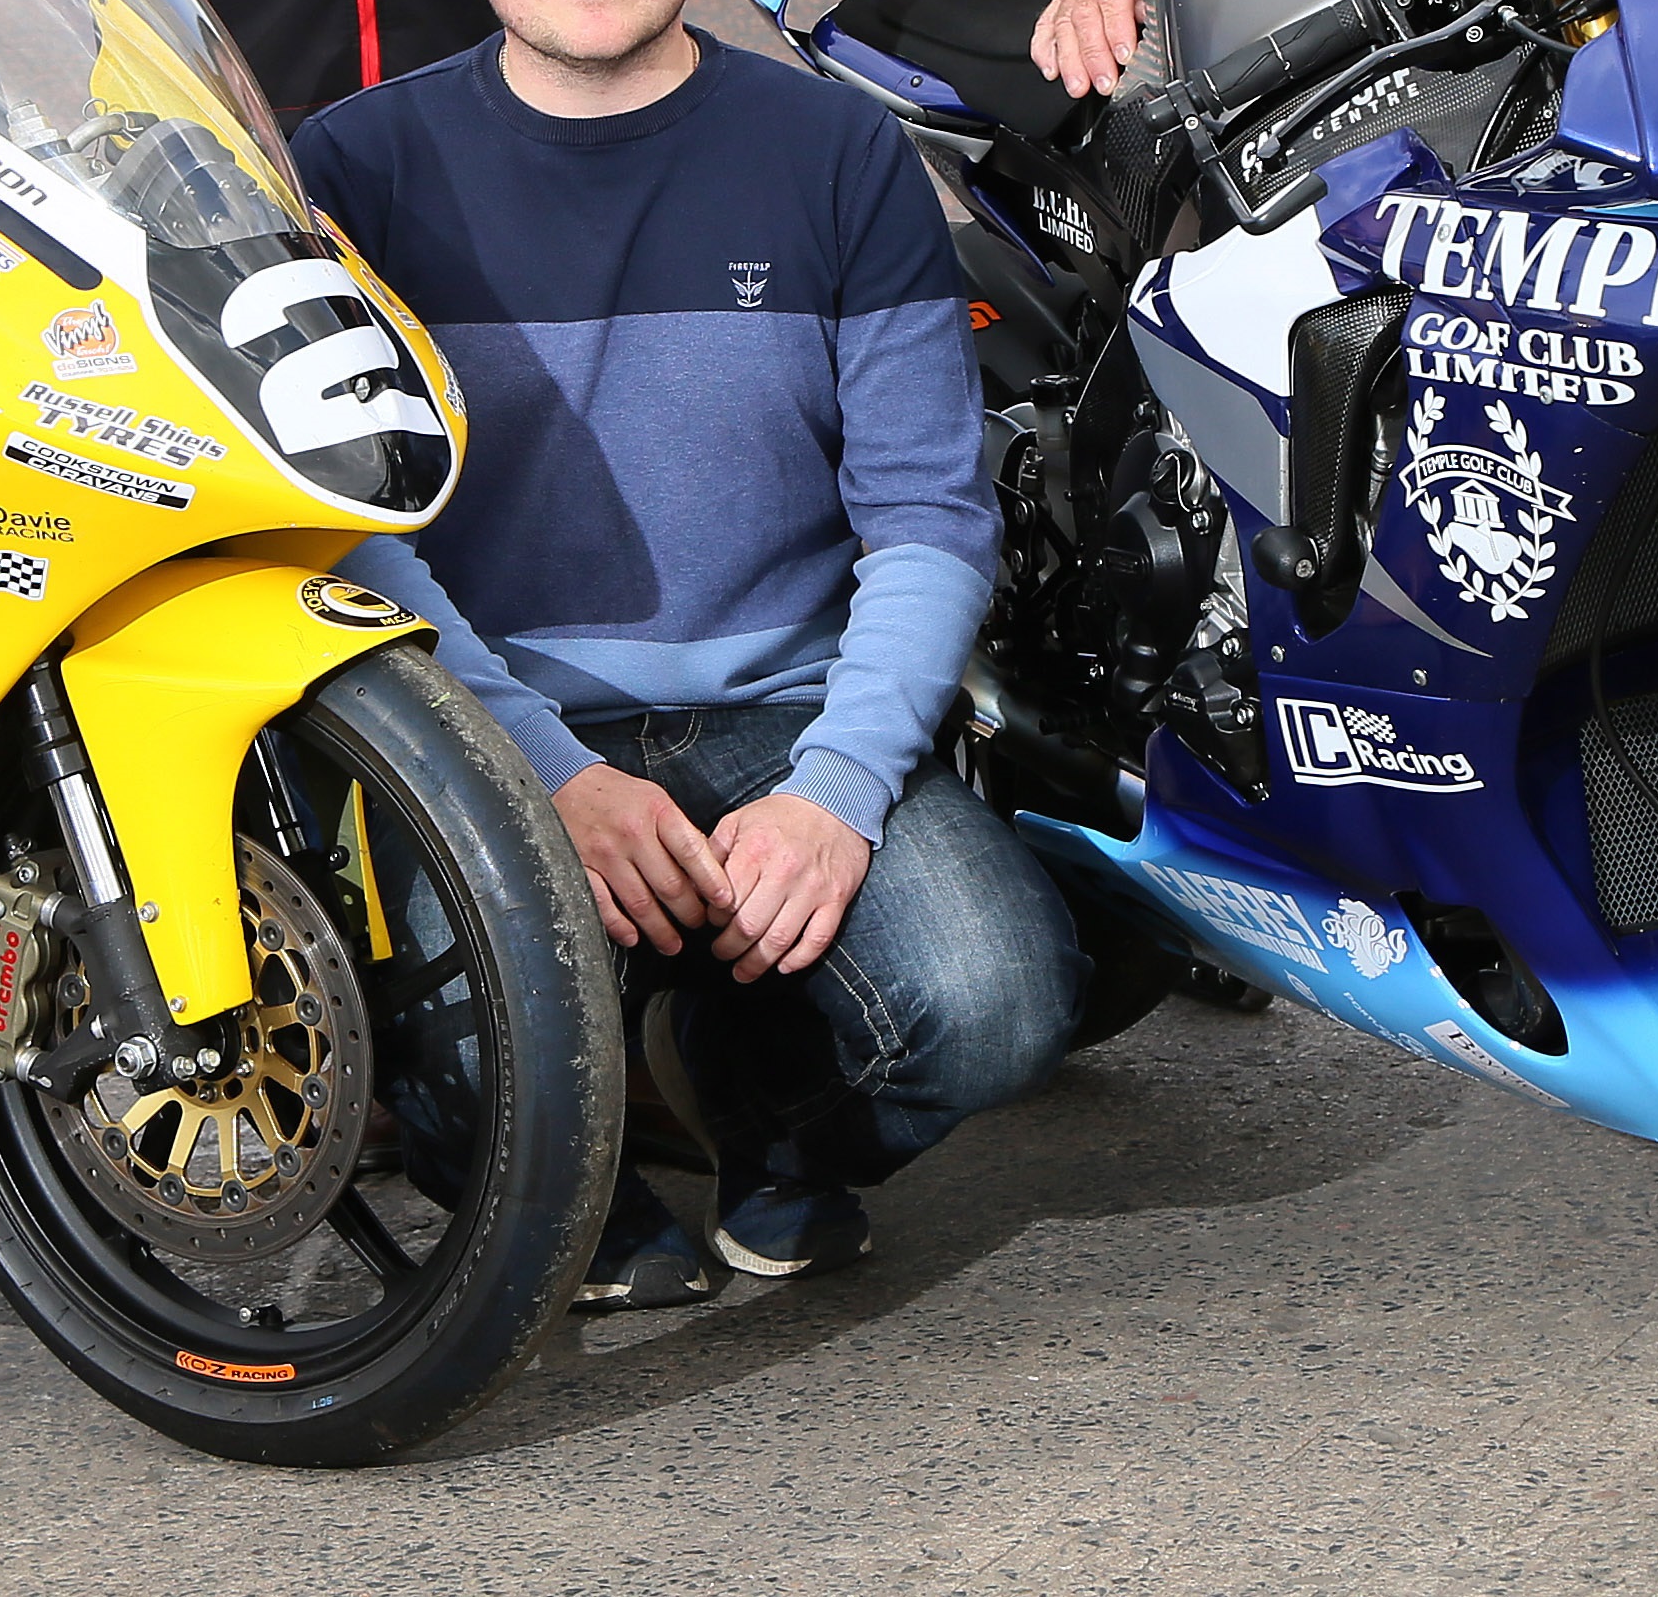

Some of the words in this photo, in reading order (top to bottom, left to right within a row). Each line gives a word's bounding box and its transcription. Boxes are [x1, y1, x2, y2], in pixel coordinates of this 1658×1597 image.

[1312, 81, 1420, 141] CENTRE
[1038, 212, 1095, 255] LIMITED
[219, 256, 447, 456] 2
[1408, 312, 1511, 358] GOLF
[1517, 328, 1645, 378] CLUB
[1406, 347, 1636, 406] LIMITED
[24, 382, 137, 428] Russell
[144, 417, 227, 460] Shiels
[37, 407, 193, 469] TYRES
[21, 439, 177, 495] COOKSTOWN
[27, 458, 162, 504] CARAVANS
[1419, 453, 1460, 478] TEMPLE
[1459, 454, 1496, 479] GOLF
[1496, 464, 1534, 495] CLUB
[304, 578, 331, 614] JOEY'S
[1354, 738, 1475, 781] Racing
[1140, 859, 1325, 951] CAFFREY
[231, 1369, 289, 1380] RACING
